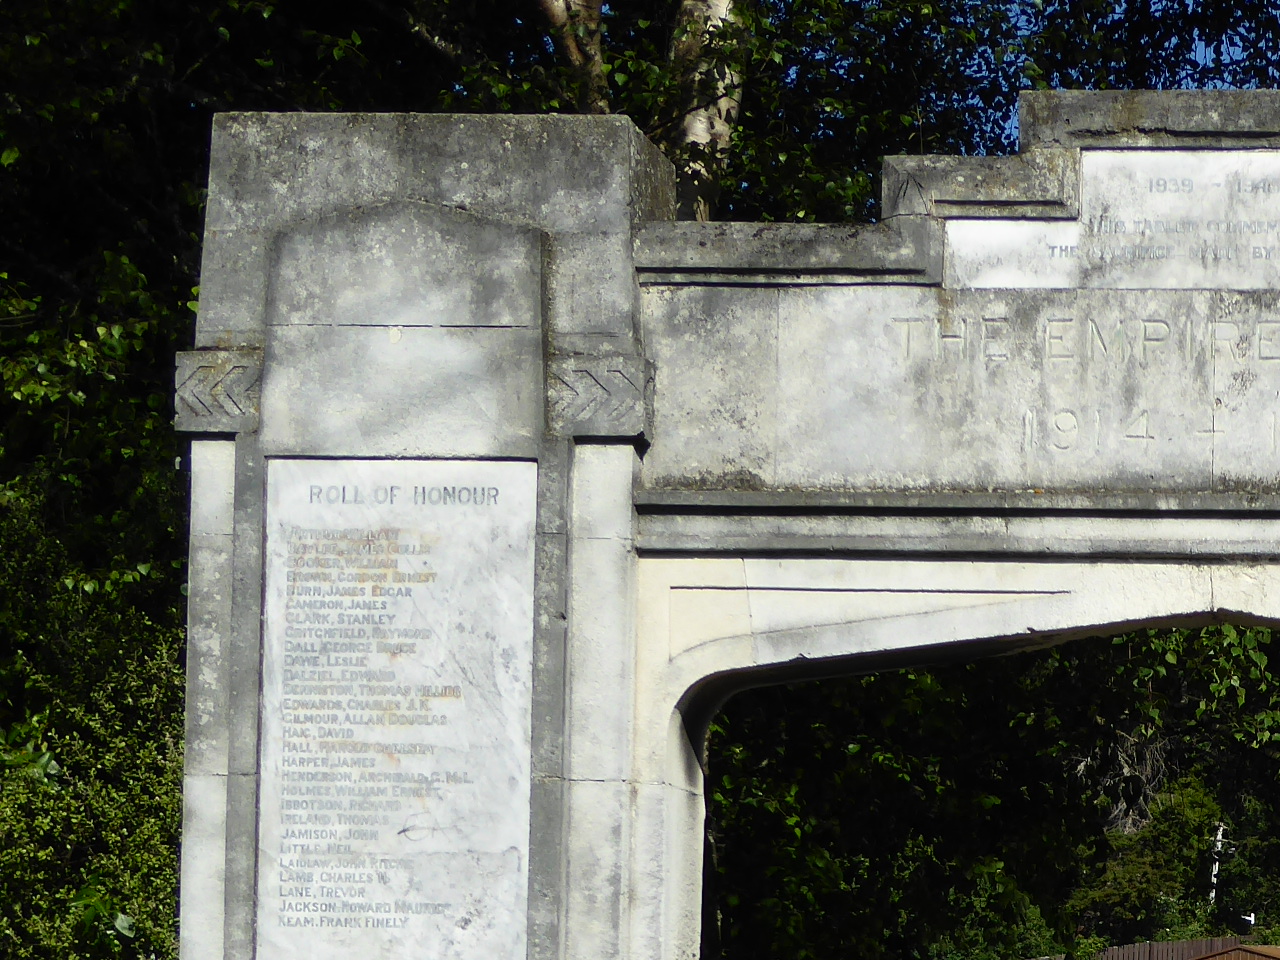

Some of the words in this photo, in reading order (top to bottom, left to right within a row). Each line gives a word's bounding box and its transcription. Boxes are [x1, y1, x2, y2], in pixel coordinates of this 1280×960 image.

[1149, 178, 1194, 193] 1939
[1048, 246, 1078, 258] THE
[1253, 246, 1276, 259] BY
[891, 317, 1009, 361] THE
[1022, 408, 1155, 451] 1914
[309, 485, 365, 504] ROLL
[375, 485, 401, 505] OF
[414, 486, 500, 506] HONOUR
[326, 585, 366, 596] JAMES
[372, 585, 412, 597] EDGAR
[348, 599, 387, 610] JAMES
[286, 613, 334, 626] CLARK,
[338, 613, 396, 625] STANLEY
[327, 655, 368, 667] LESLIE
[343, 713, 385, 725] ALLAN
[318, 727, 354, 739] DAVID
[335, 757, 376, 768] JAMES
[335, 785, 388, 797] WILLIAM
[343, 829, 379, 841] JOHN
[334, 858, 366, 870] JOHN
[320, 872, 373, 884] CHARLES
[320, 886, 366, 898] TREVOR
[320, 916, 361, 928] FRANK
